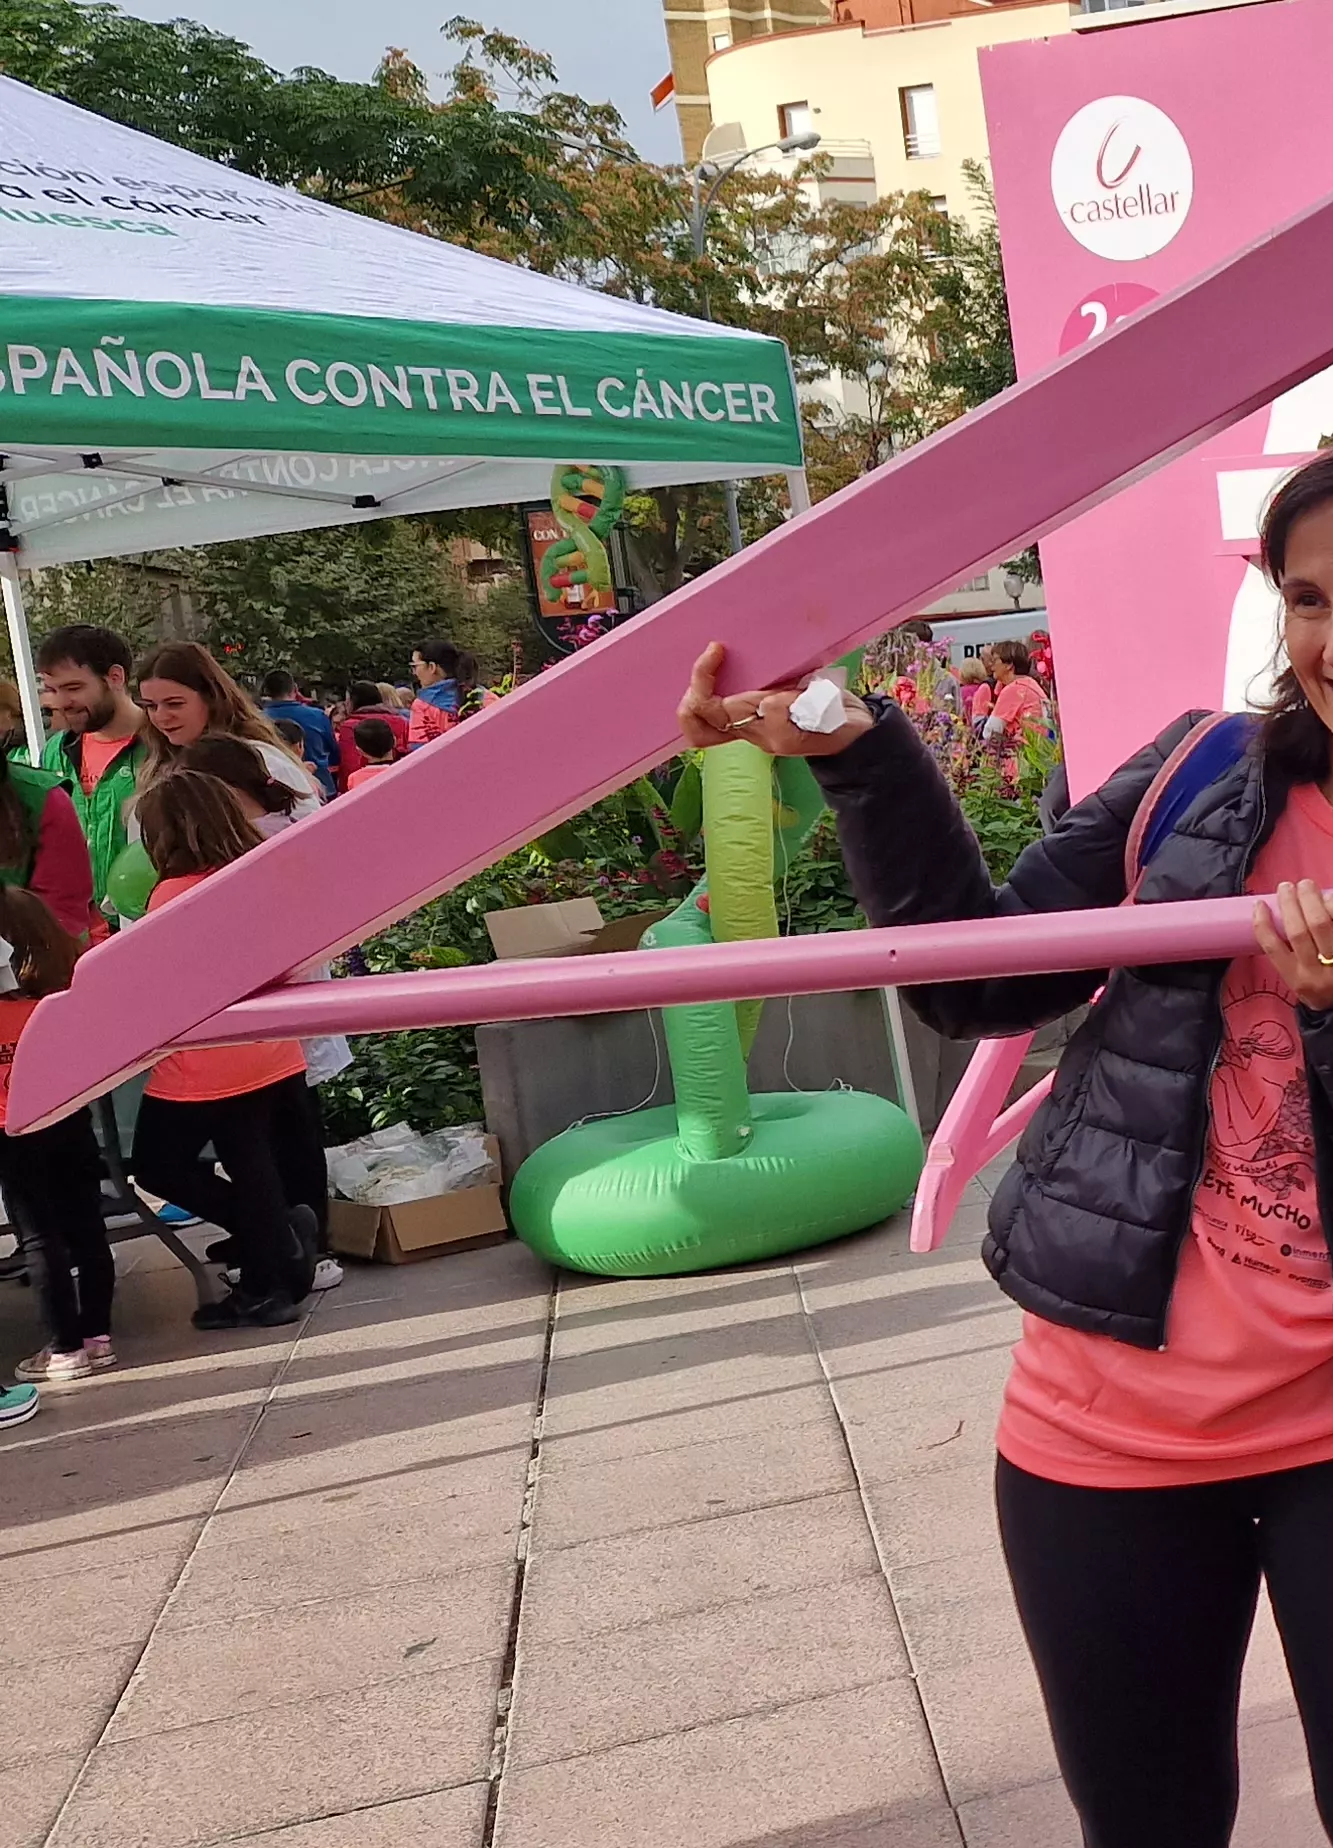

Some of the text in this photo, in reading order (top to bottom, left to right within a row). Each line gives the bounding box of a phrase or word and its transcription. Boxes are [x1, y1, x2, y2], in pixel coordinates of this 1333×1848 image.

[42, 187, 94, 207] el
[1070, 183, 1180, 224] castellar
[285, 359, 522, 415] CONTRA
[526, 374, 592, 418] EL
[597, 367, 780, 424] CÁNCER
[1240, 1195, 1312, 1230] MUCHO
